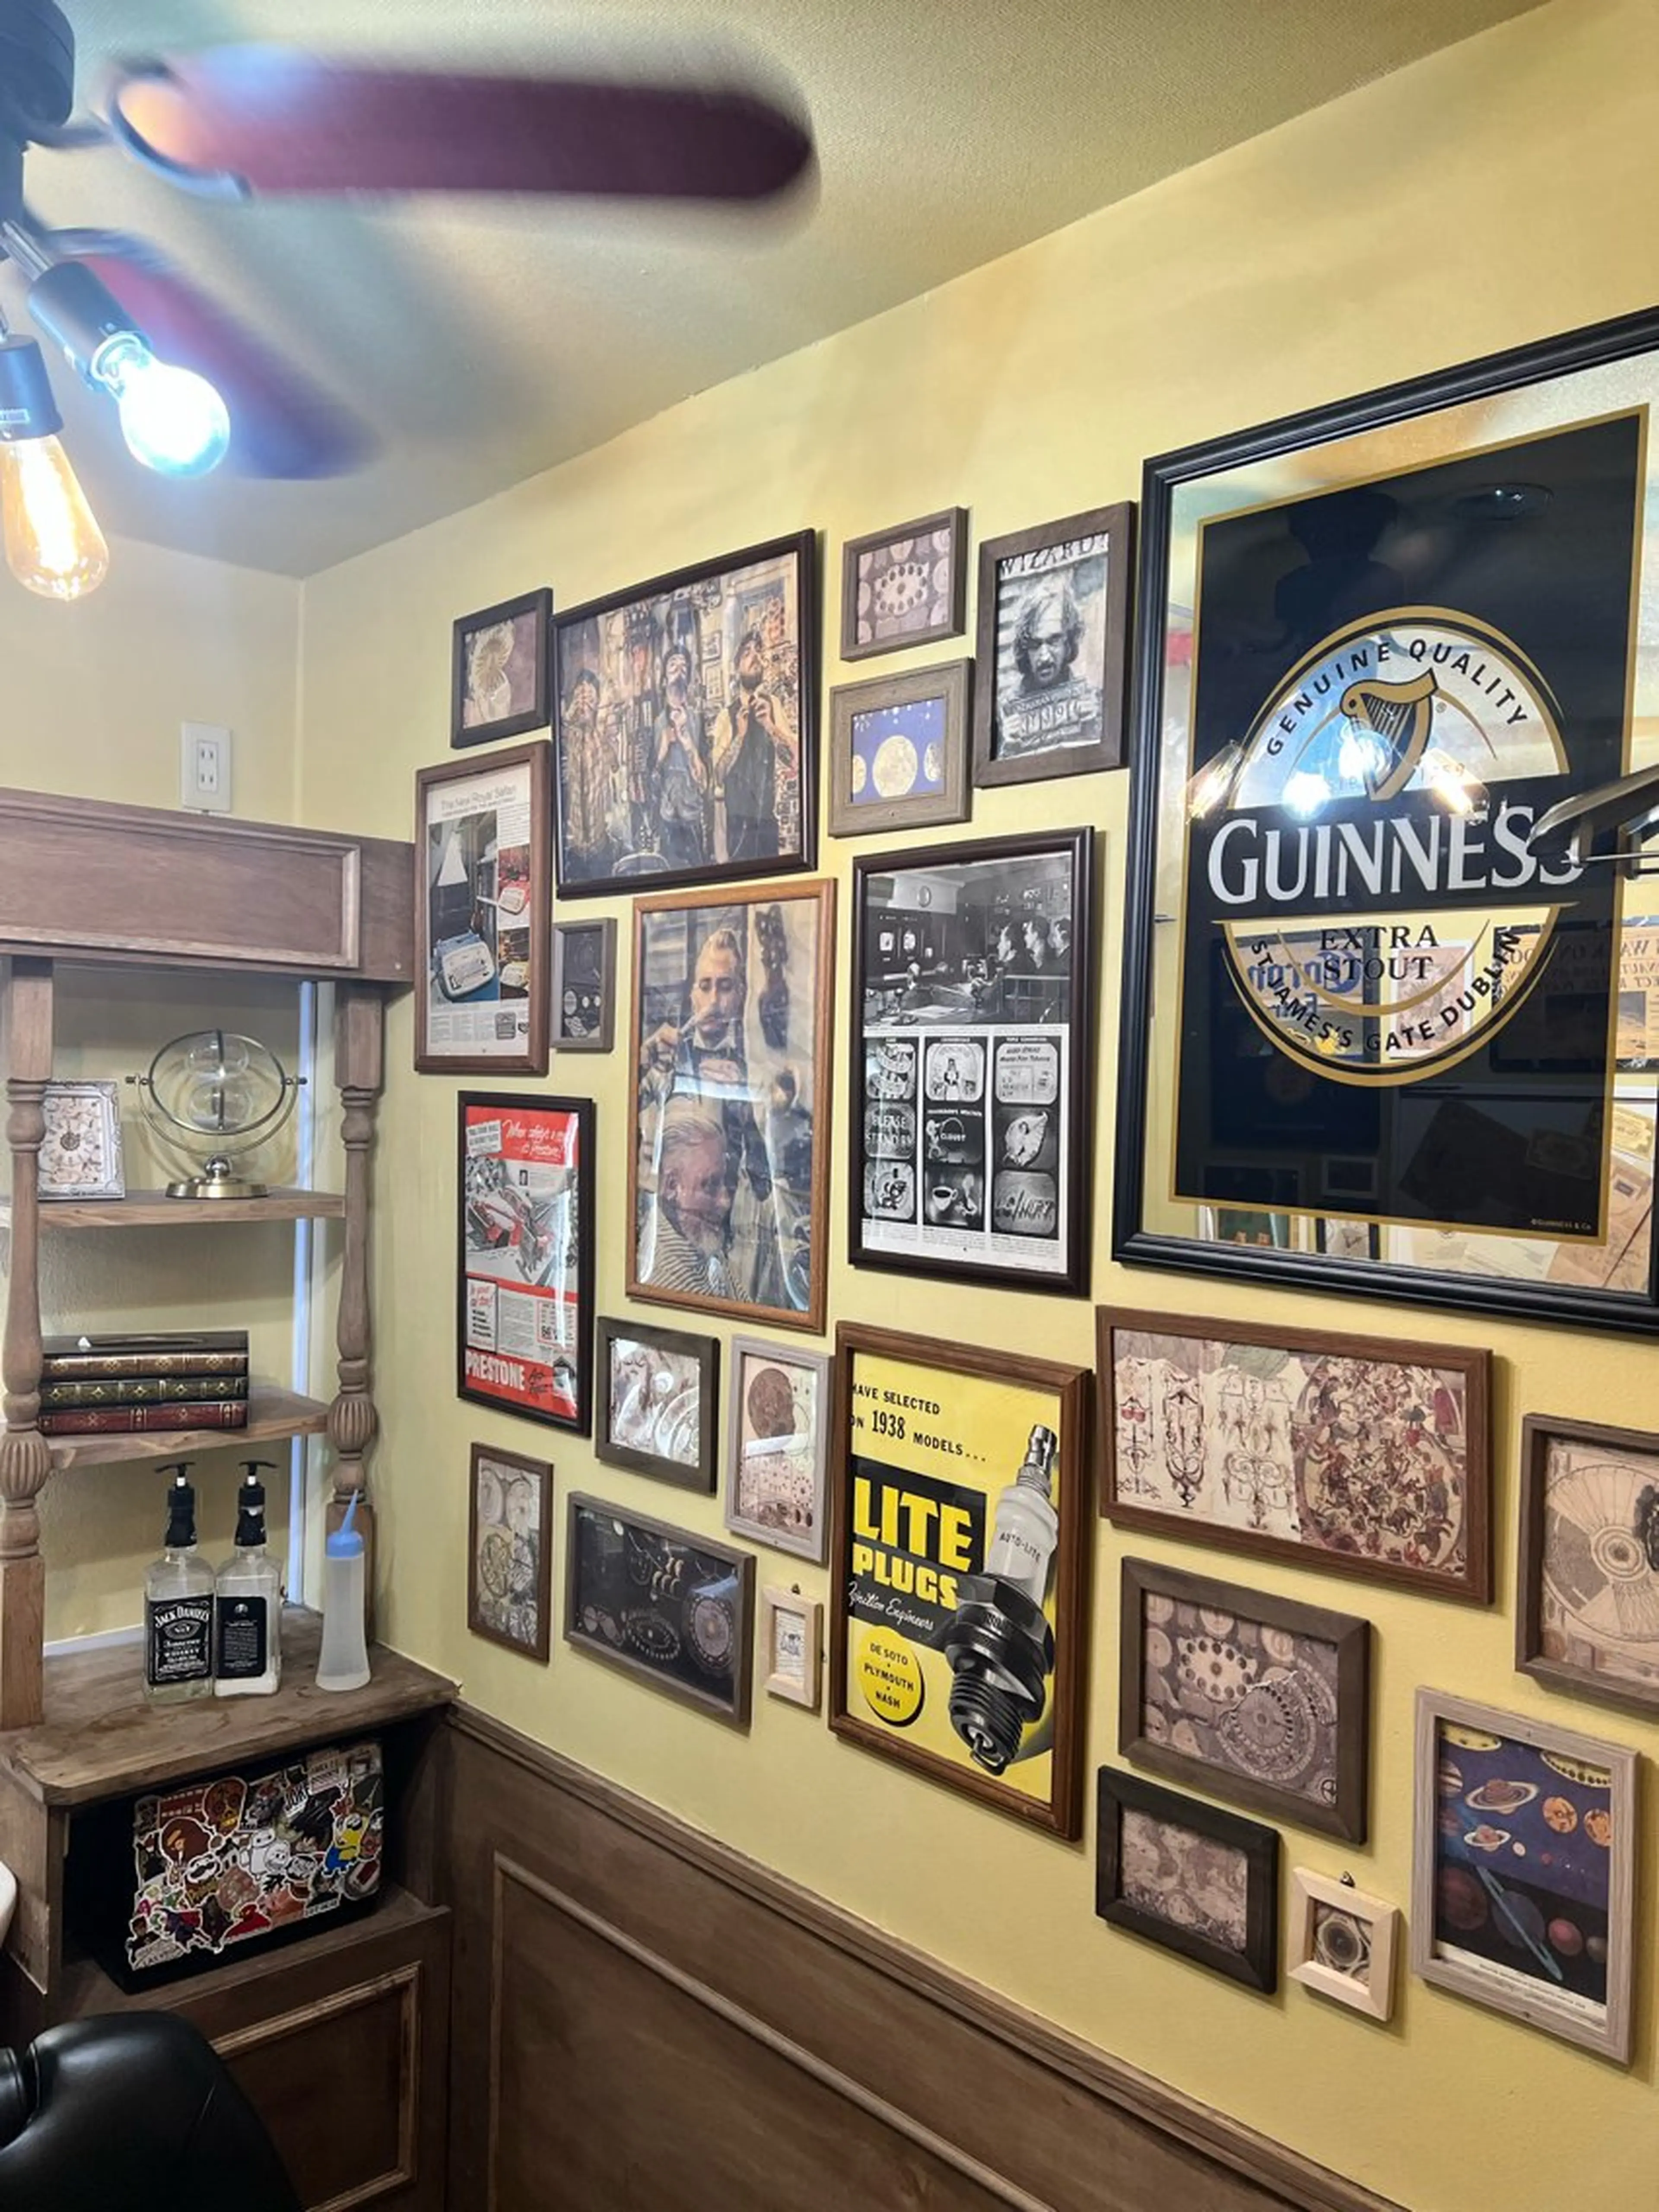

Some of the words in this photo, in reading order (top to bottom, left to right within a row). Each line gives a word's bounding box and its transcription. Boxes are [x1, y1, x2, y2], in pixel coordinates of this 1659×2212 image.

[1267, 642, 1391, 757] GENUINE
[1409, 638, 1528, 726] QUALITY
[1320, 925, 1439, 951] EXTRA
[1323, 956, 1433, 982] STOUT
[1267, 976, 1353, 1049] JAMES'S
[1367, 1022, 1433, 1052] GATE
[1443, 928, 1522, 1026] DUBLIN
[466, 1351, 525, 1391] PRESTONE
[883, 1390, 941, 1415] SELECTED
[871, 1409, 905, 1440] 1938
[854, 1477, 973, 1573] LITE
[999, 1531, 1041, 1563] AUTO-LITE
[852, 1541, 959, 1611] PLUGS
[885, 1598, 934, 1631] Engineers
[870, 1643, 882, 1656] DE
[884, 1649, 908, 1666] SOTO
[864, 1663, 914, 1691] PLYMOUTH
[875, 1691, 901, 1710] NASH
